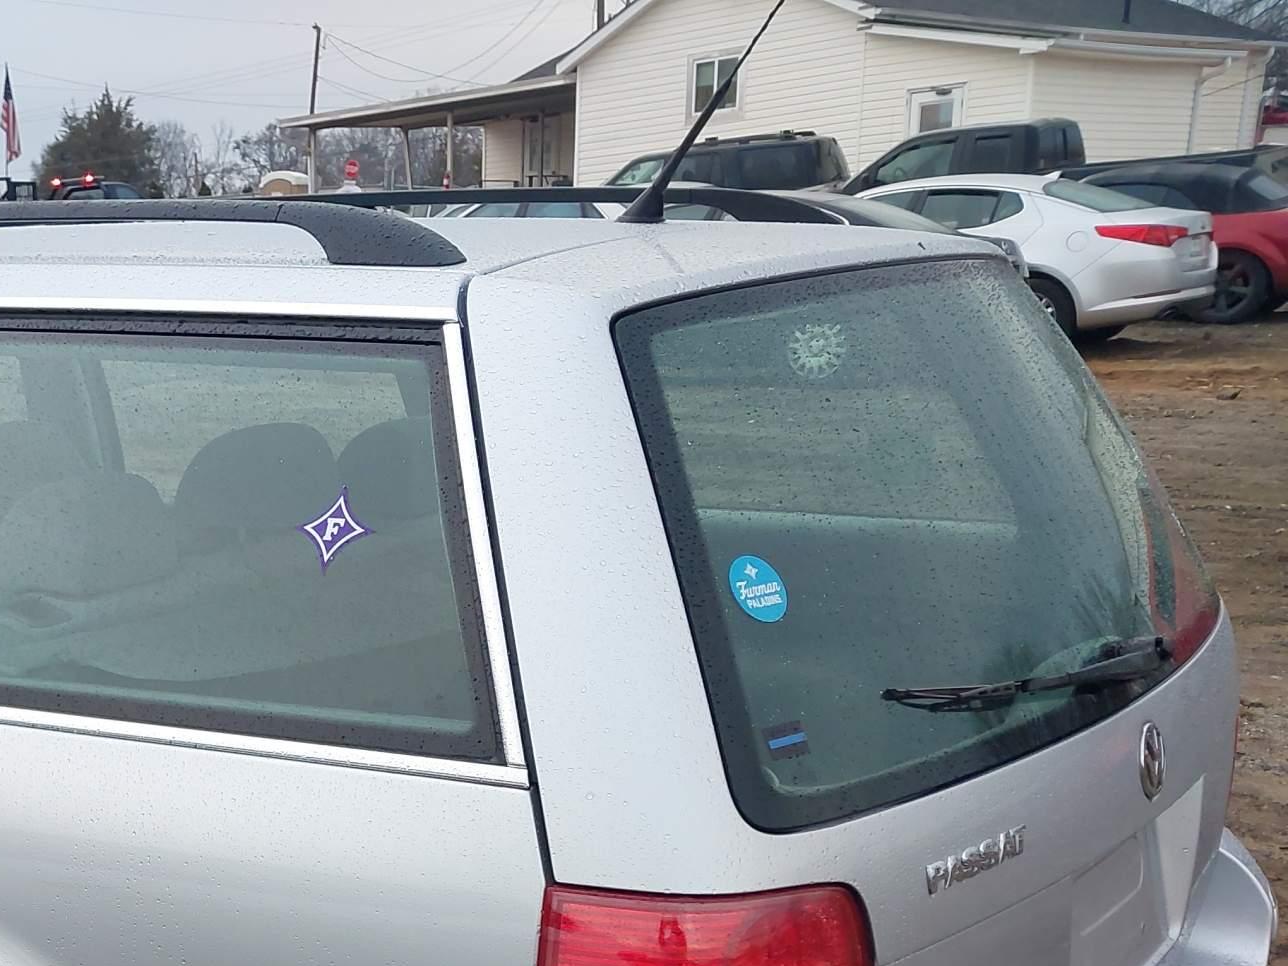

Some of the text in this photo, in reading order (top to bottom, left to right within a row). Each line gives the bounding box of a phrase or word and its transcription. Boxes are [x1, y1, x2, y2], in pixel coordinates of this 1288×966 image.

[322, 517, 346, 541] F
[735, 580, 781, 600] Furman
[925, 823, 1027, 896] PASSAT
